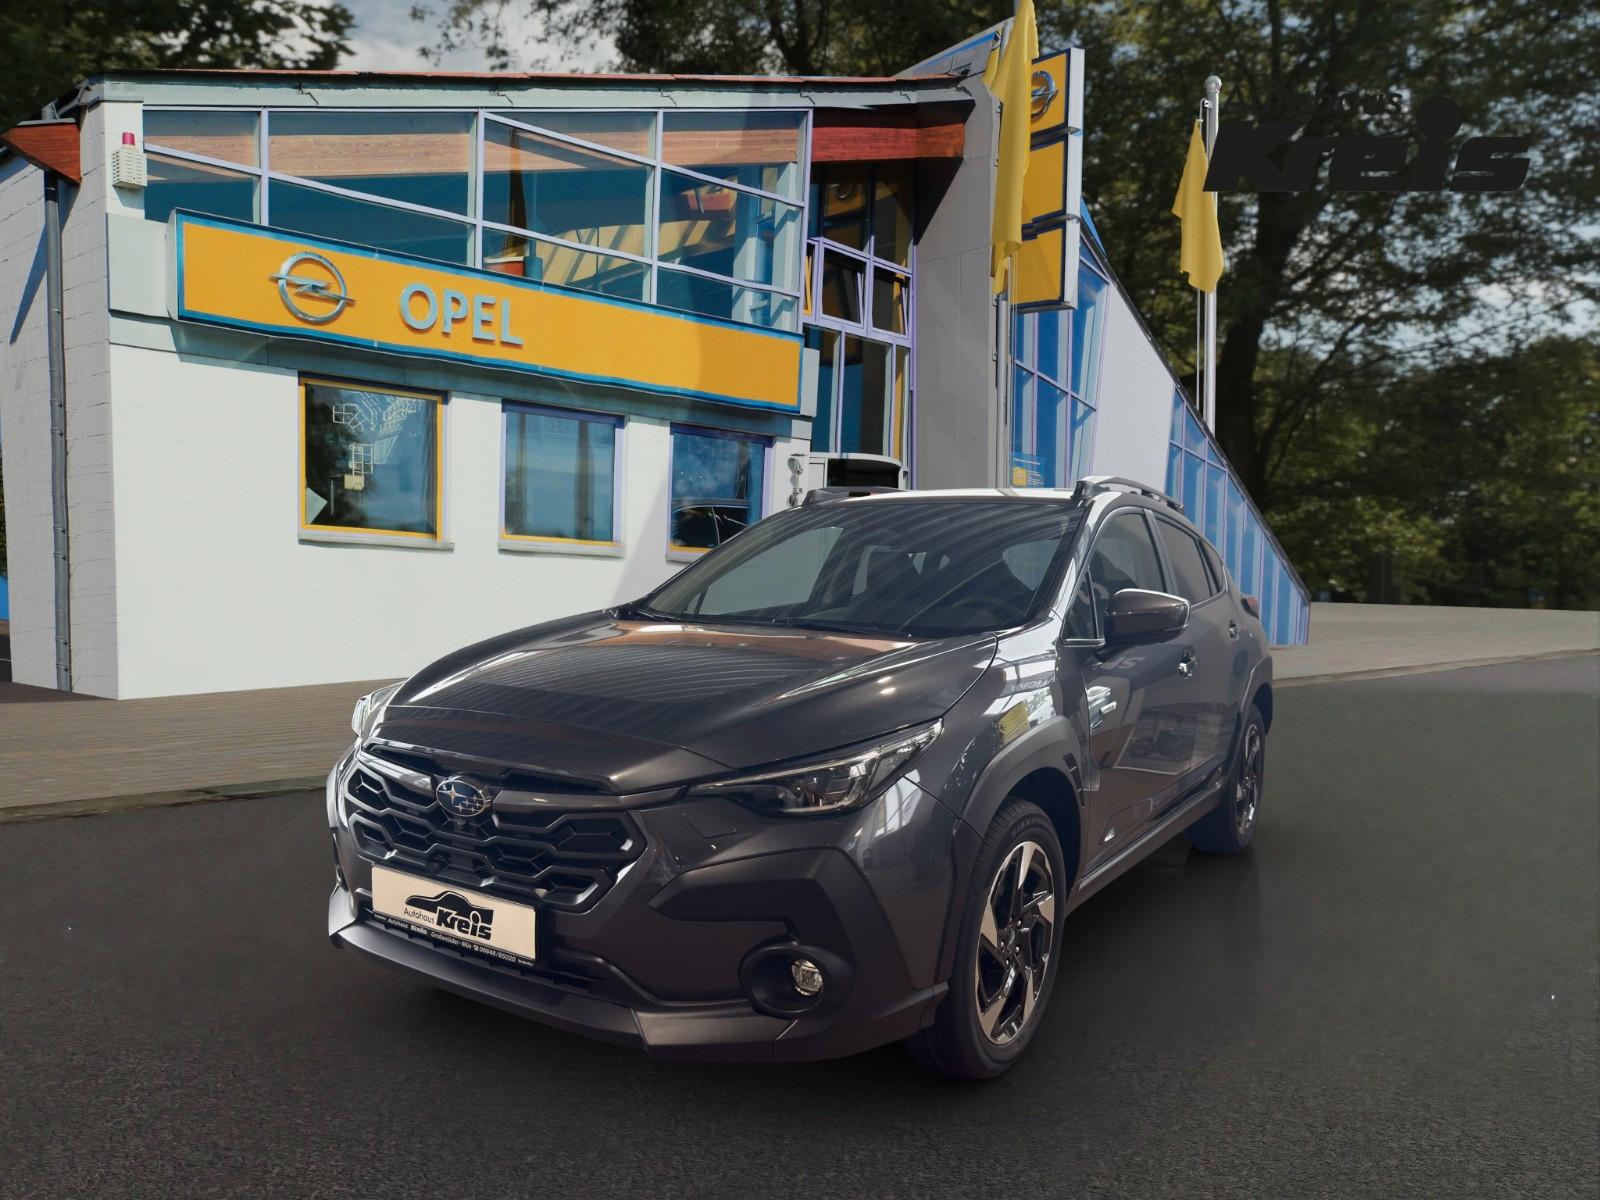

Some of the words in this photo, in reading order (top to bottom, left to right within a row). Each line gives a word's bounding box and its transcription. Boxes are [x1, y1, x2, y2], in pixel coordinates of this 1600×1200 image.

[399, 282, 524, 347] OPEL
[403, 908, 435, 925] Autohaus
[437, 909, 492, 941] Kreis
